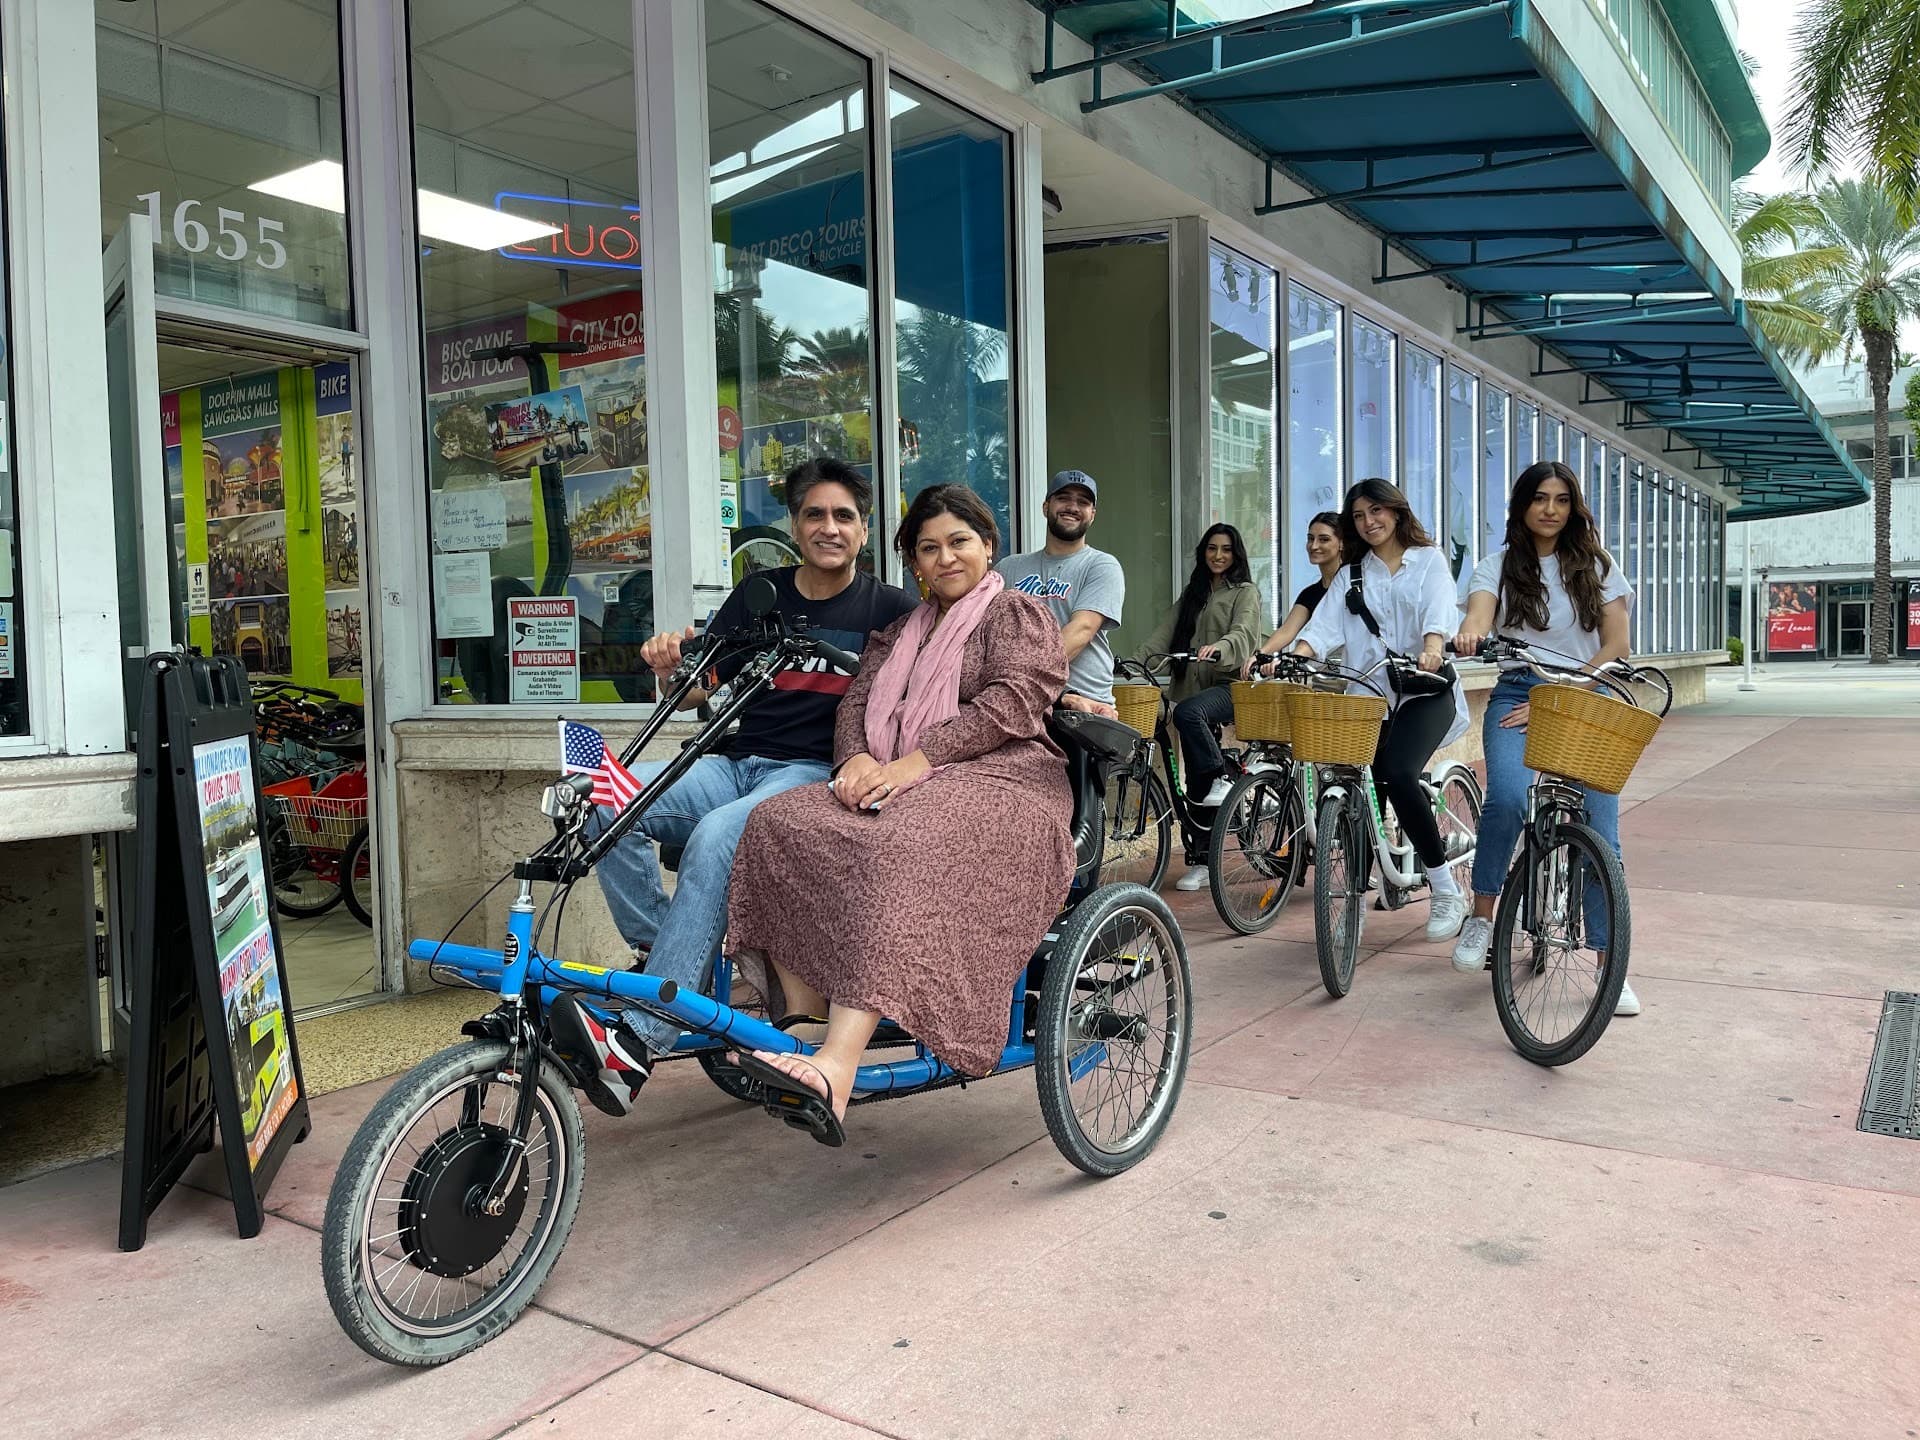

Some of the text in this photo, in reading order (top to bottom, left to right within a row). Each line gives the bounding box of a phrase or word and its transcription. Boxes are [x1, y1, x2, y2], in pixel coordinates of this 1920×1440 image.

[136, 191, 287, 270] 1655
[738, 241, 766, 265] ART
[769, 229, 813, 257] DECO
[820, 240, 861, 263] BICYCLE
[569, 318, 608, 344] CITY
[608, 337, 626, 350] LITTLE
[441, 330, 513, 363] BISCAYNE
[441, 360, 476, 385] BOAT
[208, 382, 272, 409] DOLPHIN MALL
[320, 374, 347, 399] BIKE
[203, 399, 279, 428] SAWGRASS MILLS
[518, 603, 568, 615] WARNING
[1770, 622, 1785, 633] For
[518, 652, 571, 665] ADVERTENCIA
[204, 771, 241, 806] CRUISE TOUR
[220, 958, 239, 997] MIAMI
[239, 947, 253, 978] CITY
[253, 932, 270, 961] TOUR
